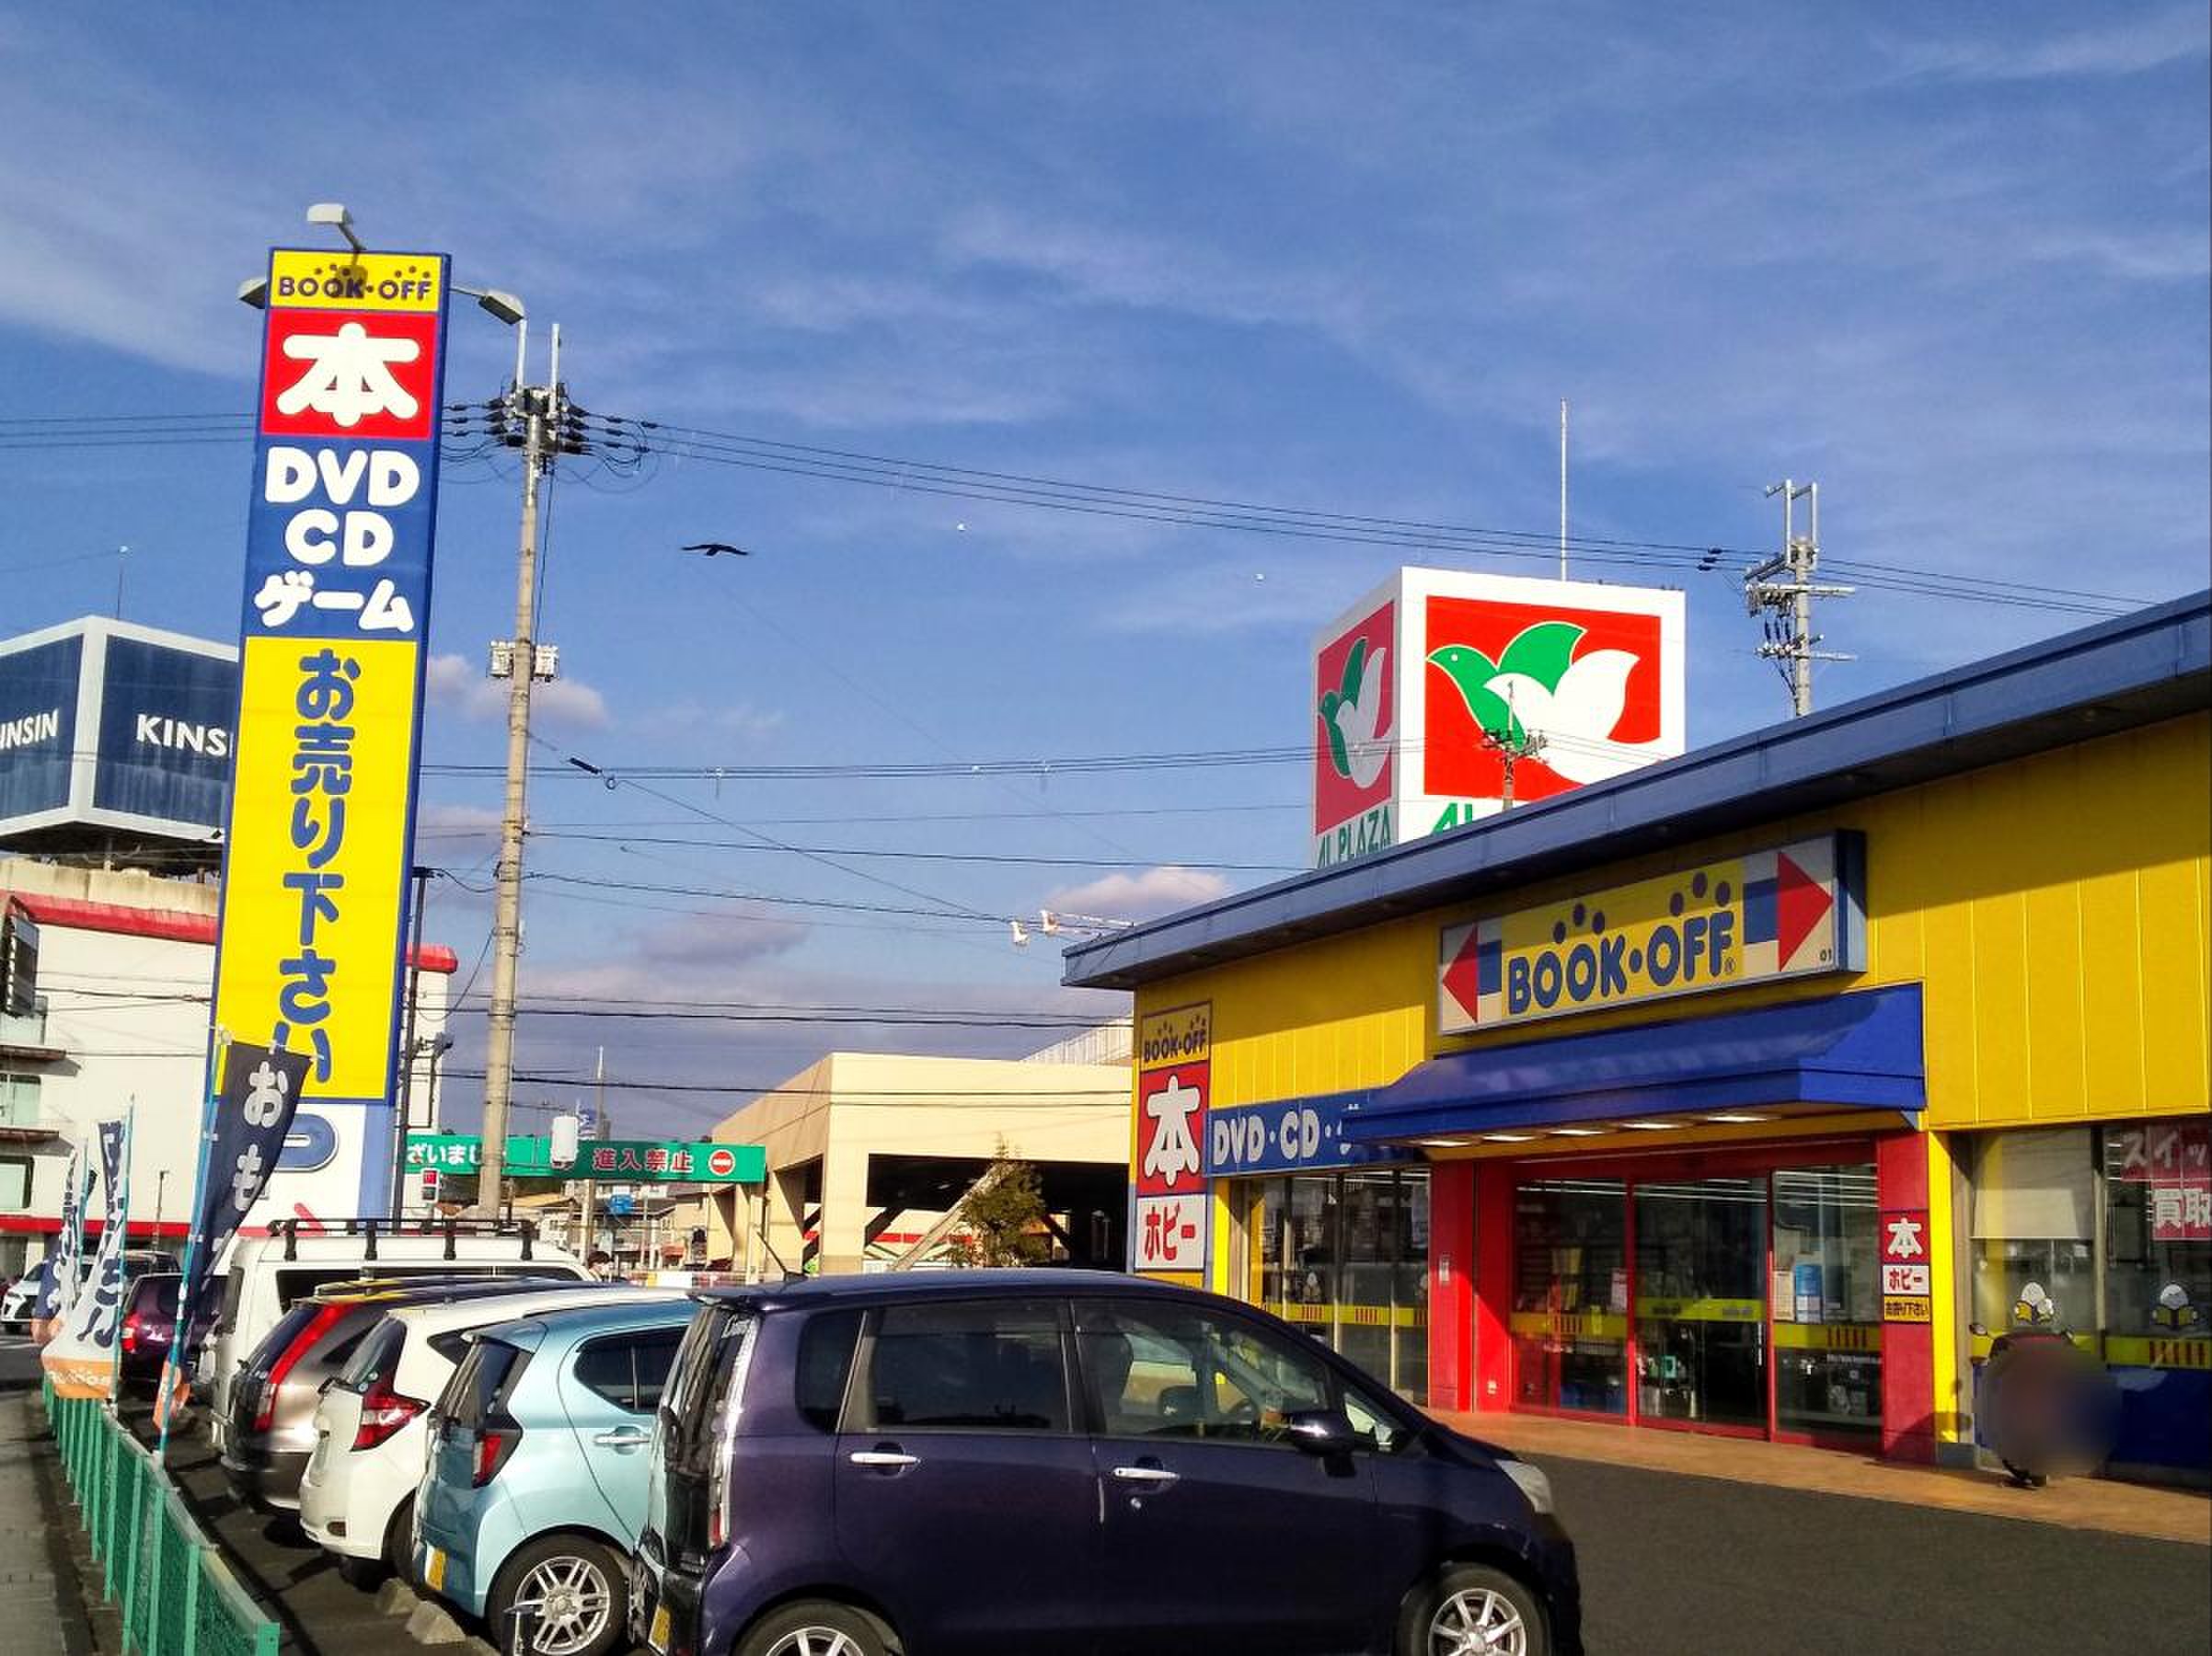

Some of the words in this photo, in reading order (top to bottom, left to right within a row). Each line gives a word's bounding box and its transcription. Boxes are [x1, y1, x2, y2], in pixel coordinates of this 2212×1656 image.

[276, 322, 421, 427] 本
[265, 447, 420, 506] DVD
[284, 509, 394, 567] CD
[254, 570, 413, 632] ゲーム
[136, 714, 234, 758] KINS
[273, 648, 362, 1083] お売り下さい
[407, 1143, 506, 1166] ざいまし
[1145, 1075, 1200, 1186] 本
[593, 1148, 694, 1174] 進入禁止
[1144, 1202, 1195, 1260] ホビー
[2153, 1188, 2212, 1229] 買取
[1887, 1217, 1923, 1259] 本
[1888, 1269, 1922, 1291] ホビー
